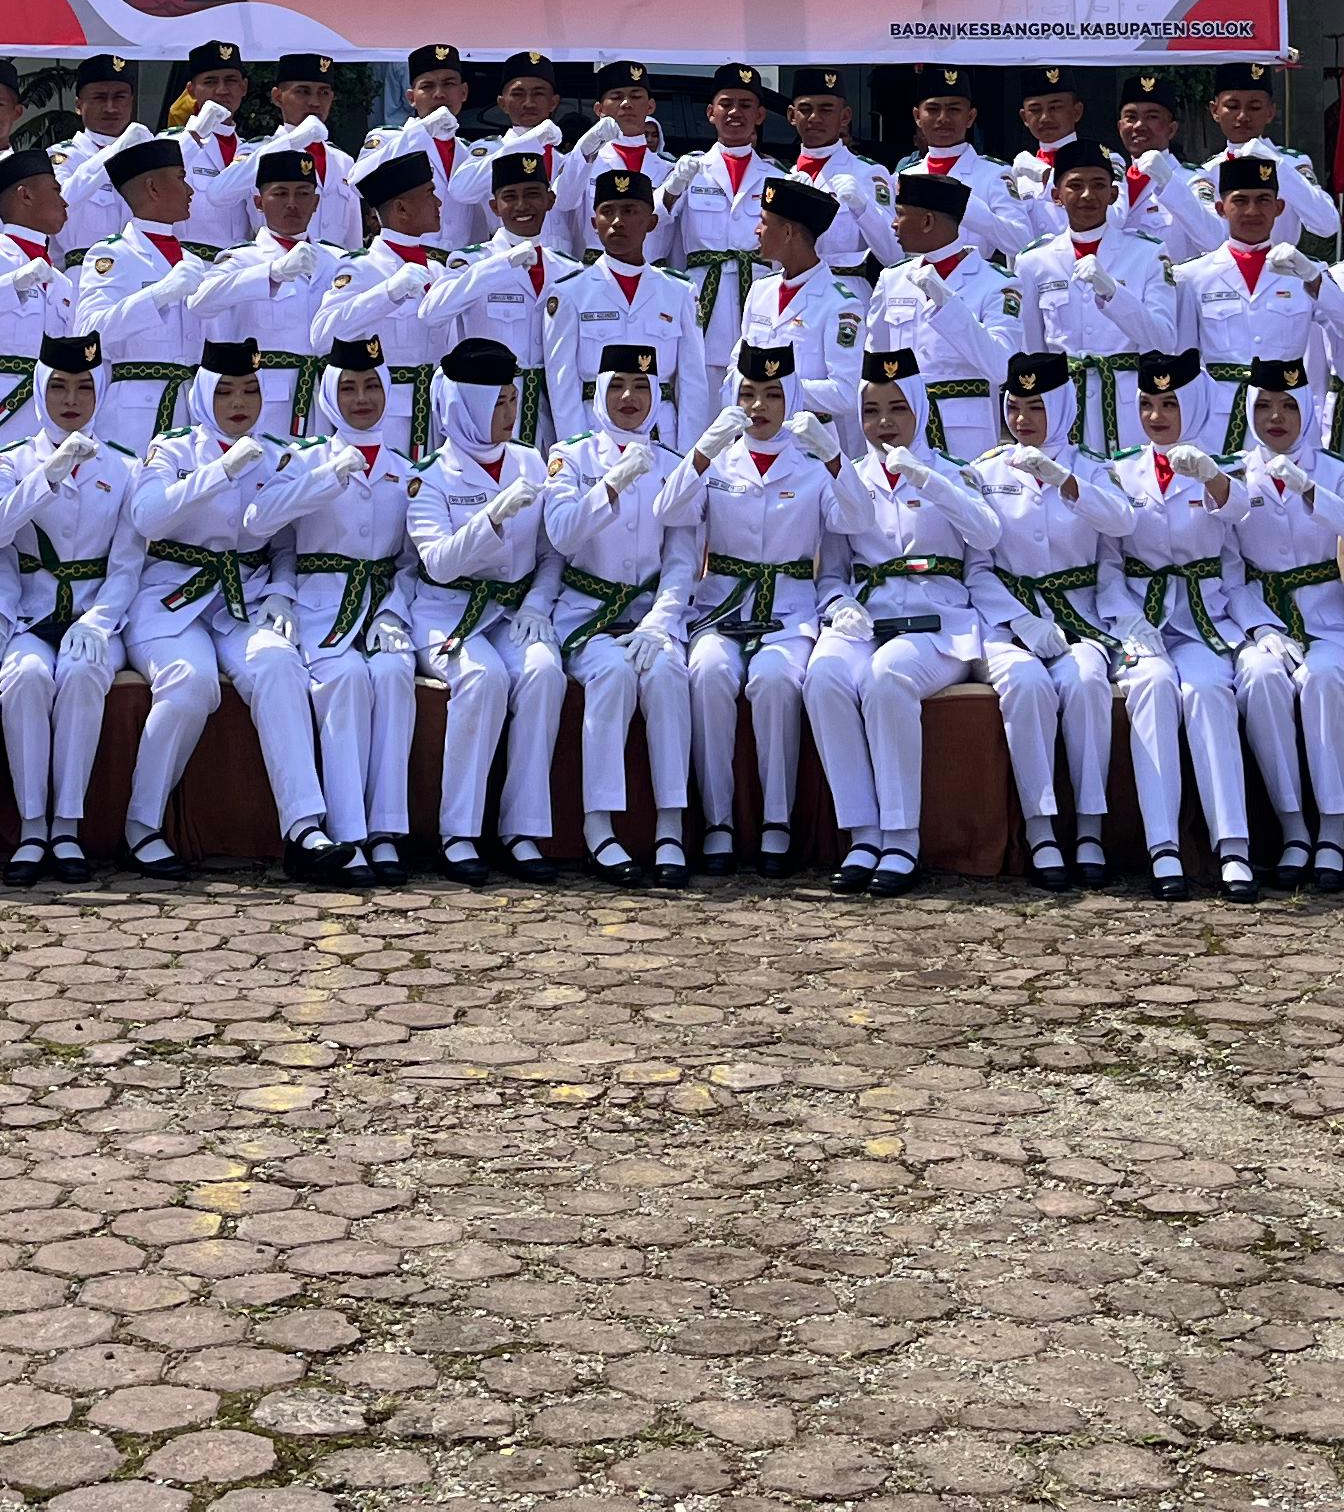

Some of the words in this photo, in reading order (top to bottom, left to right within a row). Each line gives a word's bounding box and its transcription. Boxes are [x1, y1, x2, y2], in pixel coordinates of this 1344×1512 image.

[889, 21, 954, 38] BADAN
[956, 22, 1076, 38] KESBANGPOL
[1080, 21, 1188, 38] KABUPATEN
[1189, 20, 1255, 38] SOLOK
